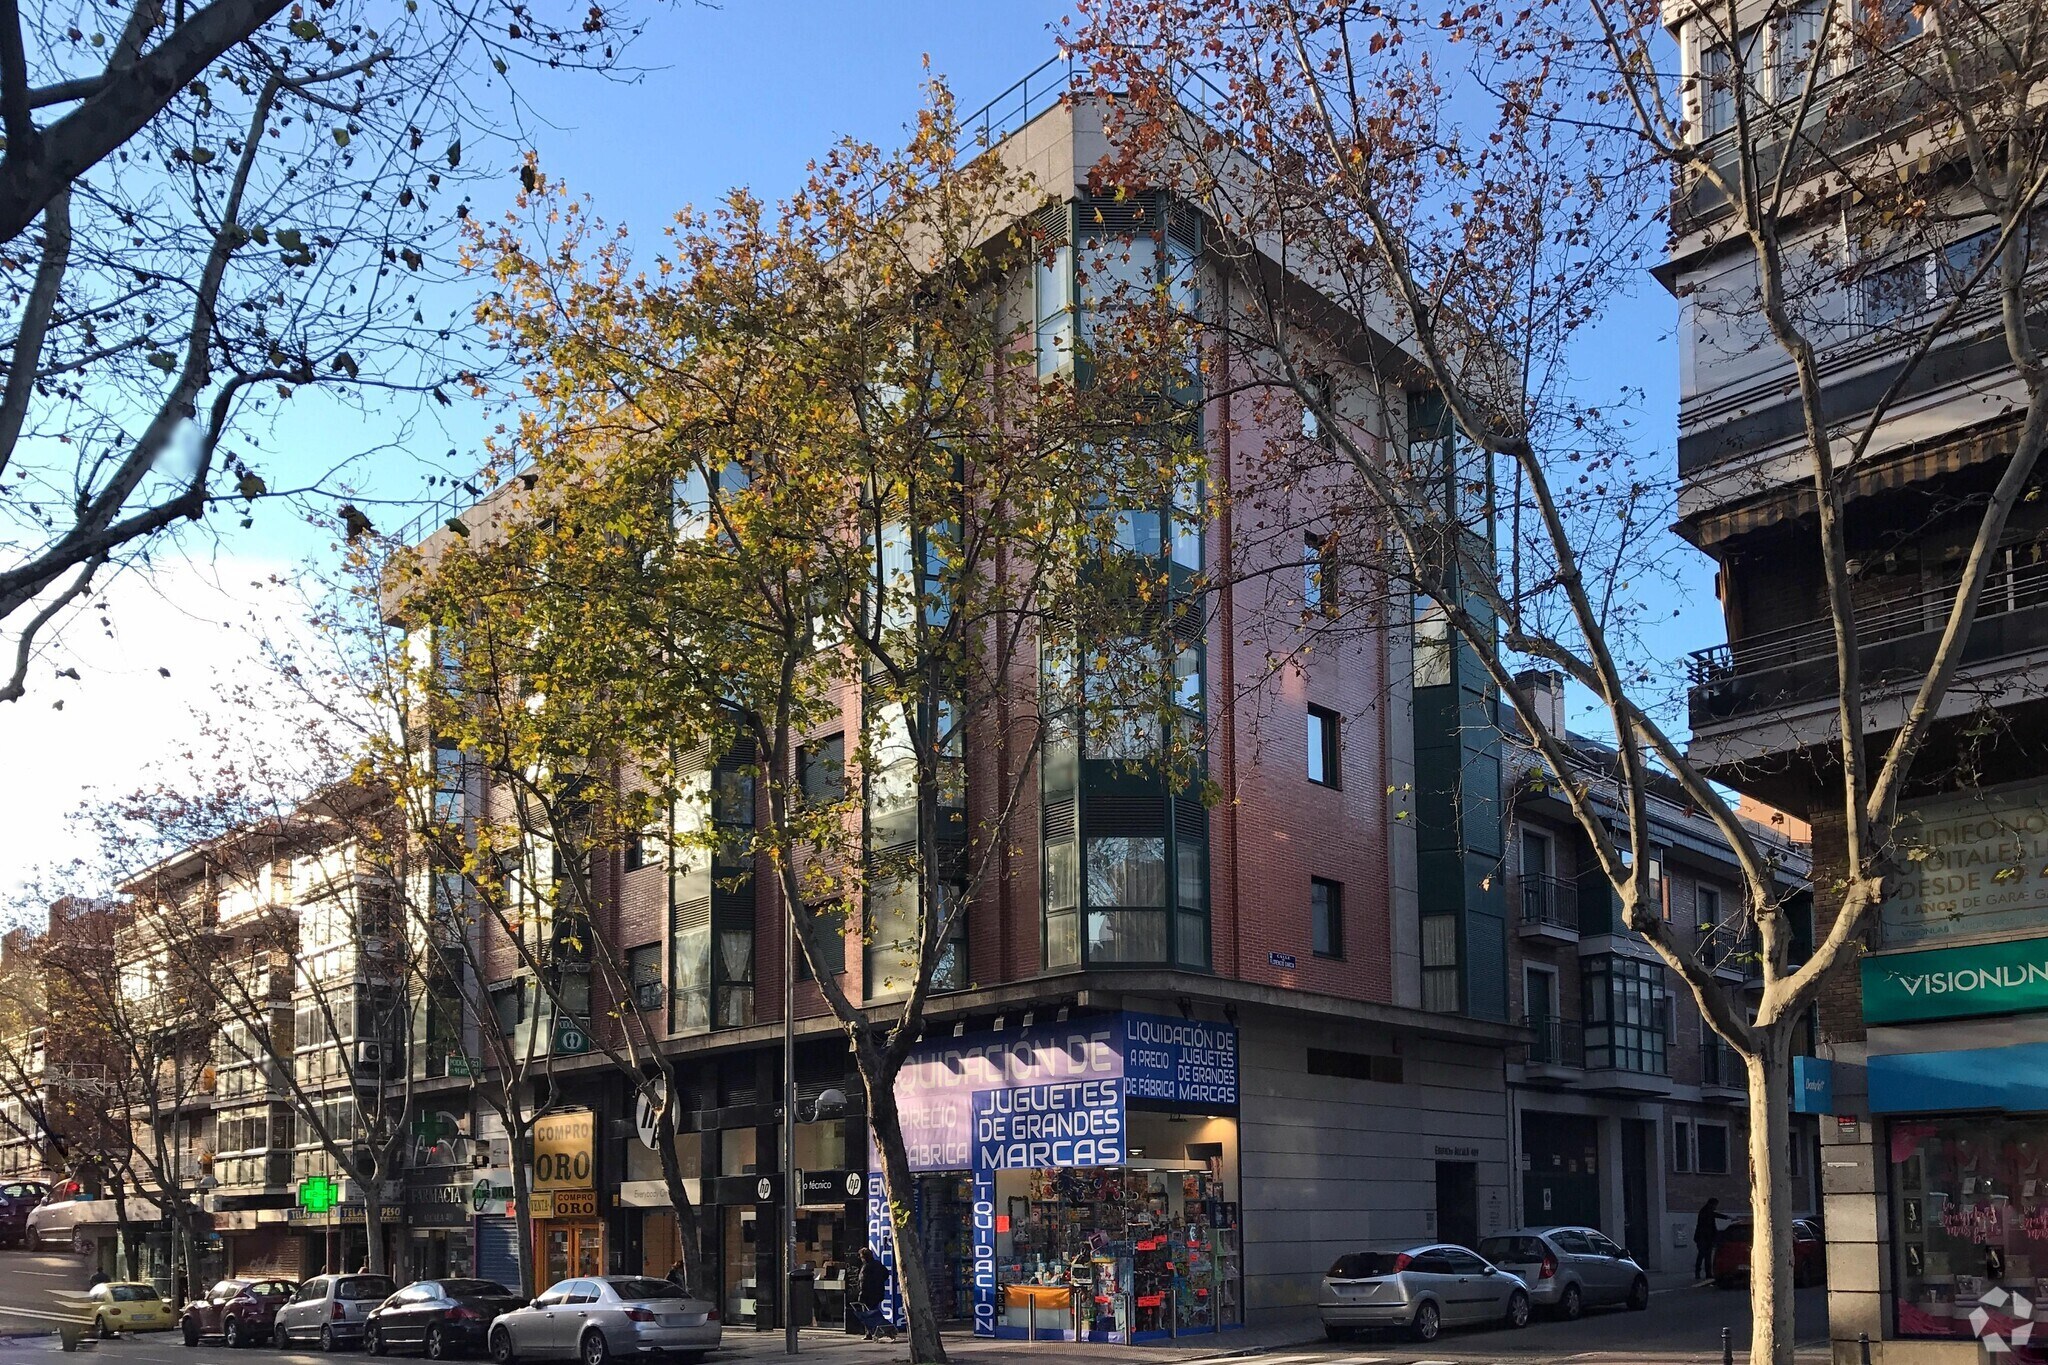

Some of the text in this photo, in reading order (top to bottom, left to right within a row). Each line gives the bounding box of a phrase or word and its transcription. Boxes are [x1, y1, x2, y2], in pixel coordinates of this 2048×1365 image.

[1899, 871, 1981, 899] DESDE
[1962, 896, 1981, 909] DE
[1127, 1020, 1234, 1051] LIQUIDACIÓN DE
[899, 1029, 1112, 1097] QUIDACIÓN DE
[1130, 1049, 1169, 1070] A PRECIO
[1178, 1047, 1234, 1068] JUGUETES
[1125, 1073, 1175, 1098] DE FÁBRICA
[1177, 1064, 1235, 1086] DE GRANDES
[980, 1079, 1119, 1116] JUGUETES
[1179, 1083, 1236, 1104] MARCAS
[538, 1123, 589, 1142] COMPRO
[978, 1108, 1121, 1143] DE GRANDES
[981, 1137, 1121, 1170] MARCAS
[536, 1150, 590, 1182] ORO
[411, 1186, 462, 1203] FARMACIA
[809, 1180, 832, 1190] técnico
[557, 1193, 593, 1201] COMPRO
[343, 1207, 400, 1217] TELA PESO
[557, 1202, 594, 1214] ORO
[973, 1172, 994, 1332] LIQUIDACION
